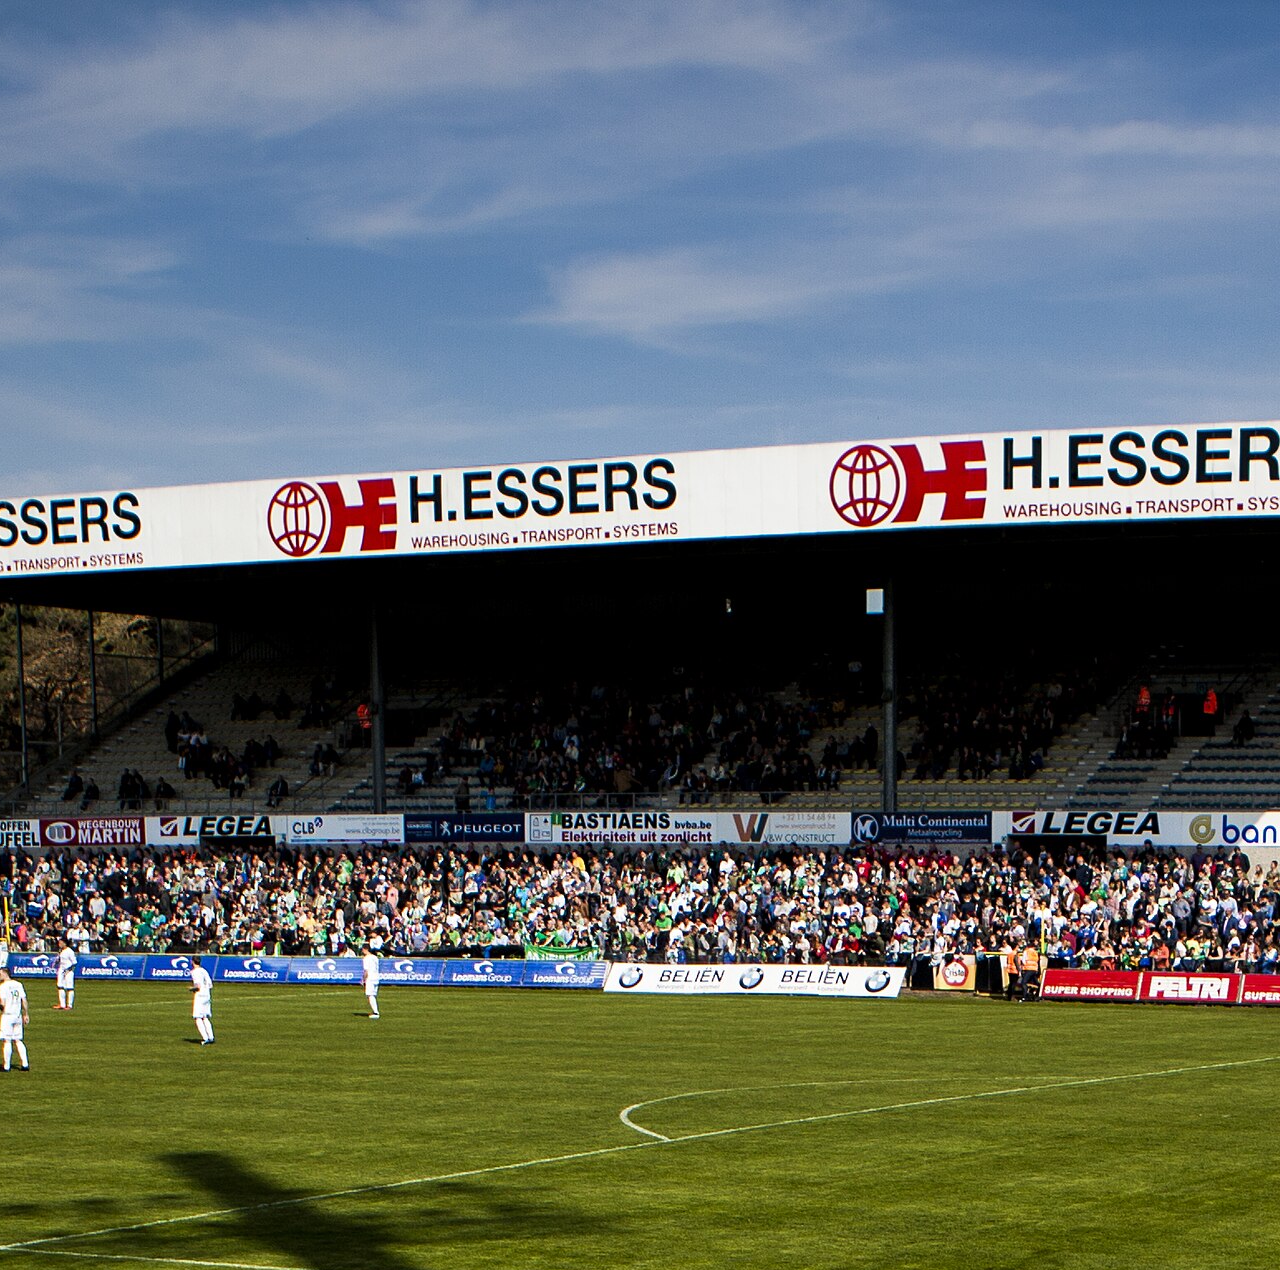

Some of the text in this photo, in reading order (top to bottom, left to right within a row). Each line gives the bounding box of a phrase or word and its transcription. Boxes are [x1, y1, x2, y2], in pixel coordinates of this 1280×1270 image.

[410, 458, 677, 523] H.ESSERS
[1003, 502, 1122, 518] WAREHOUSING
[1135, 498, 1235, 514] TRANSPORT
[411, 522, 678, 549] WAREHOUSING TRANSPORT SYSTEMS
[14, 556, 81, 572] TRANSPORT
[90, 552, 144, 567] SYSTEMS
[78, 819, 140, 829] WEGENBOUW
[183, 816, 272, 836] LEGEA
[561, 813, 712, 830] BASTIAENS bvba.be
[882, 814, 988, 827] Multi Continental
[1041, 812, 1160, 835] LEGEA
[292, 821, 315, 835] CLB
[454, 823, 522, 834] PEUGEOT
[907, 828, 963, 838] Metaalrecycling
[78, 829, 141, 844] MARTIN
[561, 831, 712, 842] Elektriciteit uit zonlicht
[783, 833, 836, 843] CONSTRUCT
[13, 965, 43, 975] Loomans
[81, 966, 113, 977] Loomans
[151, 967, 184, 977] Loomans
[223, 969, 278, 980] Loomans Group
[297, 970, 354, 981] Loomans Group
[378, 971, 432, 982] oomans Group
[452, 972, 512, 984] Loomans Group
[533, 973, 595, 985] Loomans Group
[659, 969, 725, 984] BELIËN
[781, 969, 849, 985] BELIËN
[1044, 986, 1133, 997] SUPER SHOPPING
[1149, 976, 1229, 999] PELTRI
[1244, 991, 1280, 1001] SUPER
